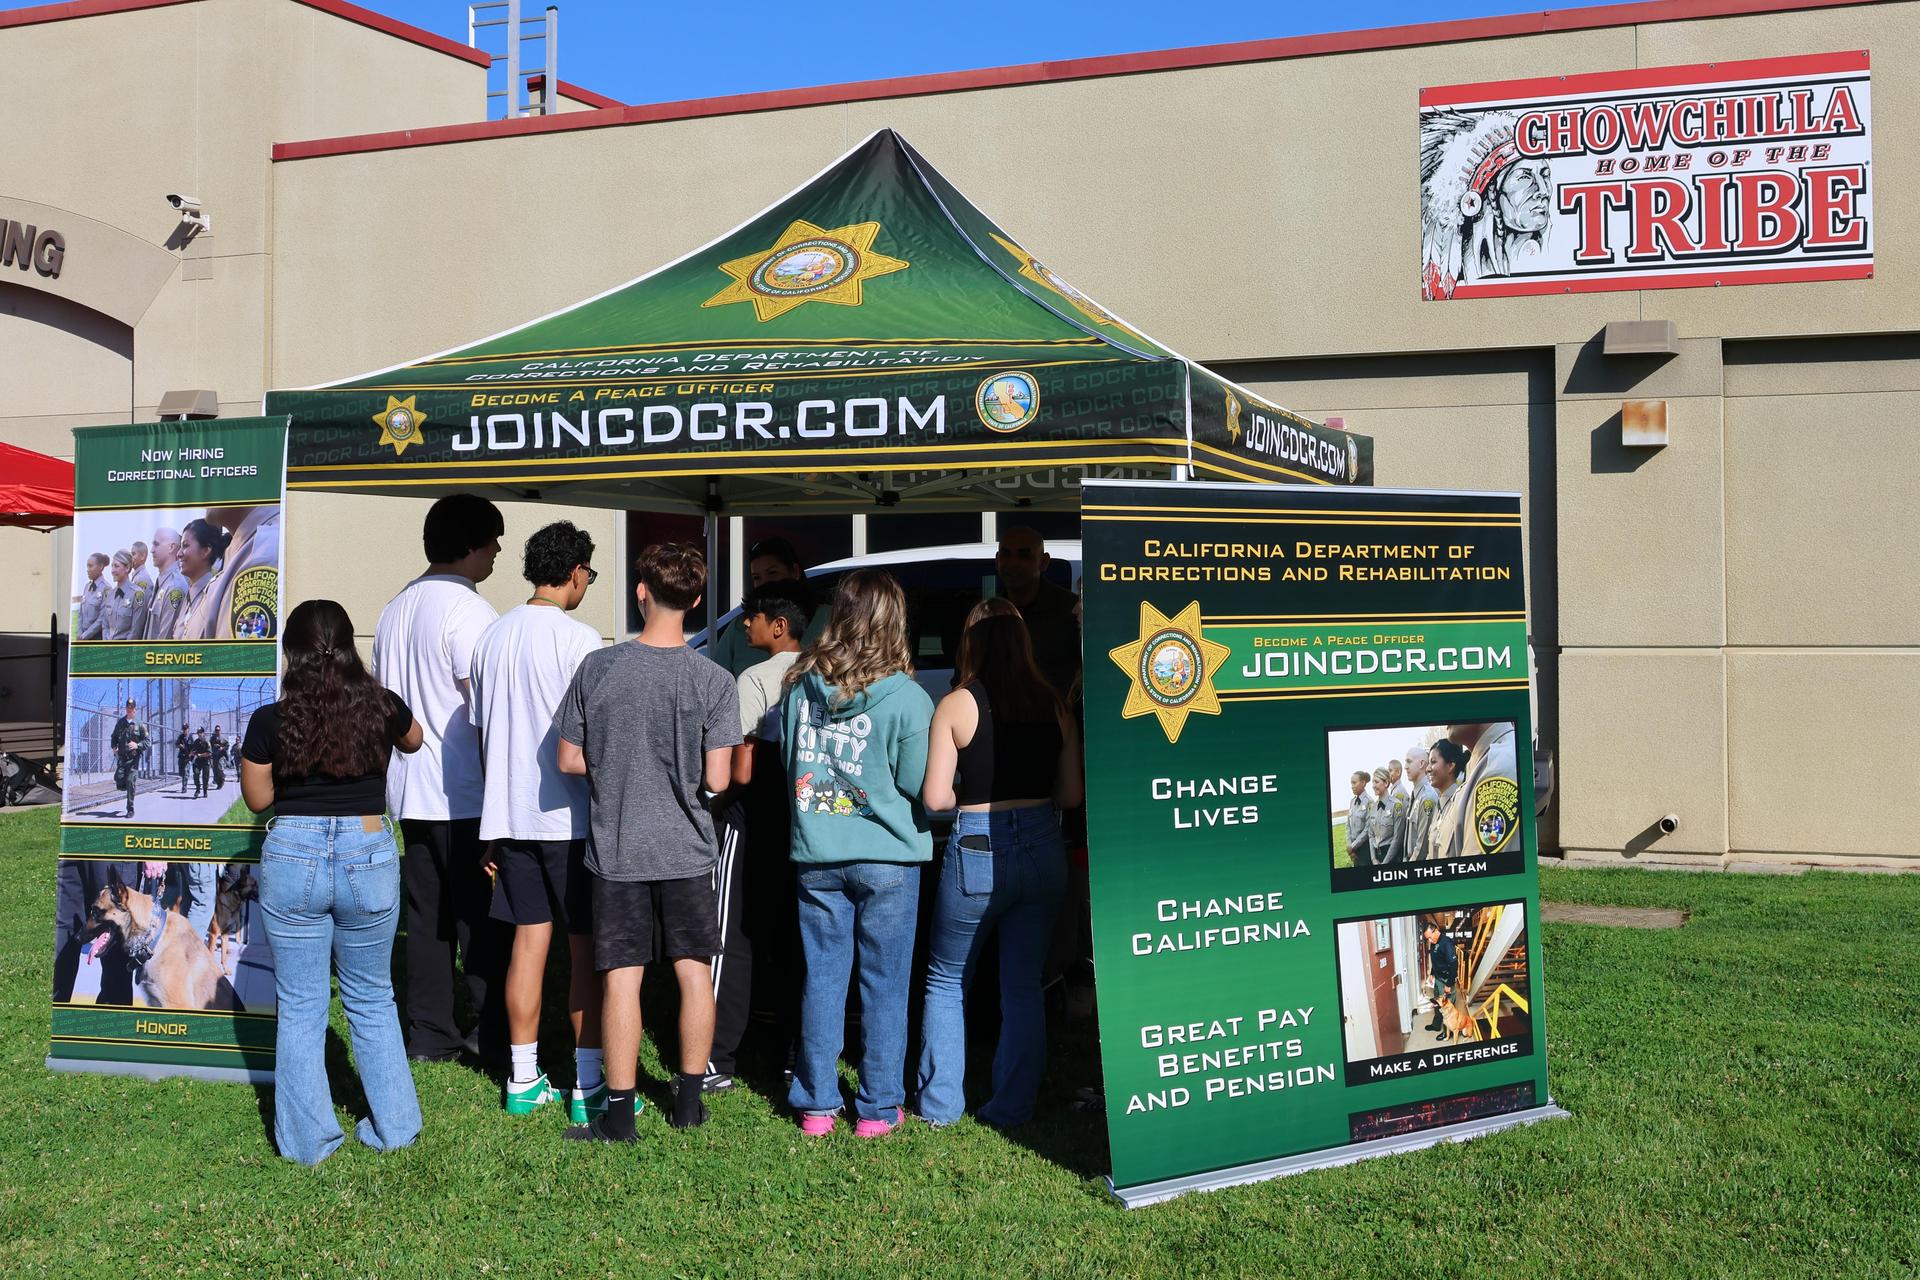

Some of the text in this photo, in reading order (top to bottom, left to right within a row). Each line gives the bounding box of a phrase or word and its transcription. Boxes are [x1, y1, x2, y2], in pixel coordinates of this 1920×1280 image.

[1514, 85, 1866, 160] CHOWCHILLA
[1595, 142, 1832, 176] HOME OF THE
[1557, 162, 1868, 266] TRIBE
[465, 356, 985, 381] CORRECTIONS AND REHABILITATION
[521, 356, 679, 371] CALIFORNIA
[692, 350, 889, 362] DEPARTMENT
[1073, 366, 1136, 390] CDCR
[471, 383, 775, 407] BECOME A PEACE OFFICER
[1062, 392, 1125, 418] CDCR
[451, 395, 945, 451] JOINCDCR.COM
[1120, 410, 1185, 433] CDCR
[141, 447, 225, 463] NOW HIRING
[1245, 413, 1346, 479] JOINCDCR.COM
[108, 465, 258, 482] CORRECTIONAL OFFICERS
[1143, 539, 1476, 559] CALIFORNIA DEPARTMENT OF
[1099, 563, 1511, 582] CORRECTIONS AND REHABILITATION
[1253, 633, 1426, 648] BECOME A PEACE OFFICER
[144, 651, 203, 665] SERVICE
[1242, 645, 1512, 679] JOINCDCR.COM
[798, 724, 867, 761] KITTY
[796, 750, 815, 763] ND
[1151, 774, 1279, 800] CHANGE
[1173, 805, 1260, 829] LIVES
[124, 835, 212, 850] EXCELLENCE
[1372, 861, 1488, 883] JOIN THE TEAM
[1157, 891, 1284, 922] CHANGE
[1132, 919, 1312, 956] CALIFORNIA
[136, 1019, 188, 1036] HONOR
[1140, 1006, 1315, 1049] GREAT PAY
[1158, 1038, 1304, 1078] BENEFITS
[1370, 1043, 1519, 1078] MAKE A DIFFERENCE
[1125, 1063, 1336, 1115] AND PENSION
